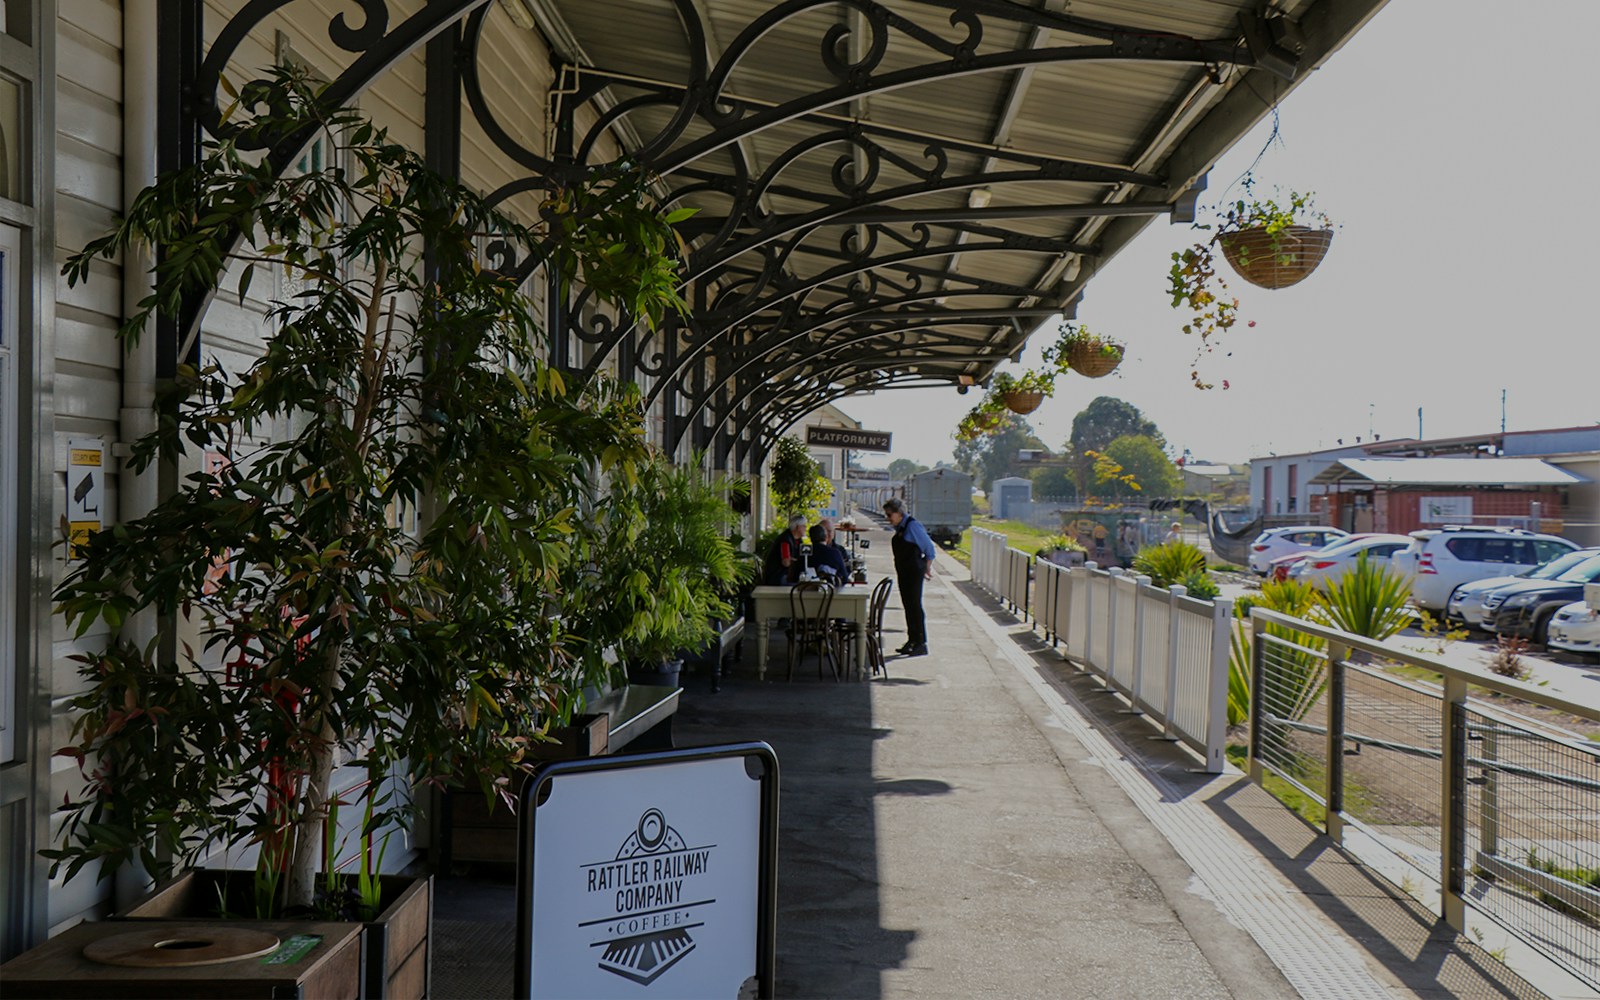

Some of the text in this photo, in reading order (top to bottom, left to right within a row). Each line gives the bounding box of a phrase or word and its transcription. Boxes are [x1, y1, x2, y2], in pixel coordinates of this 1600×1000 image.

[809, 431, 866, 445] PLATFORM
[587, 851, 710, 892] RATTLER RAILWAY
[615, 880, 683, 913] COMPANY
[616, 911, 682, 935] COFFEE
